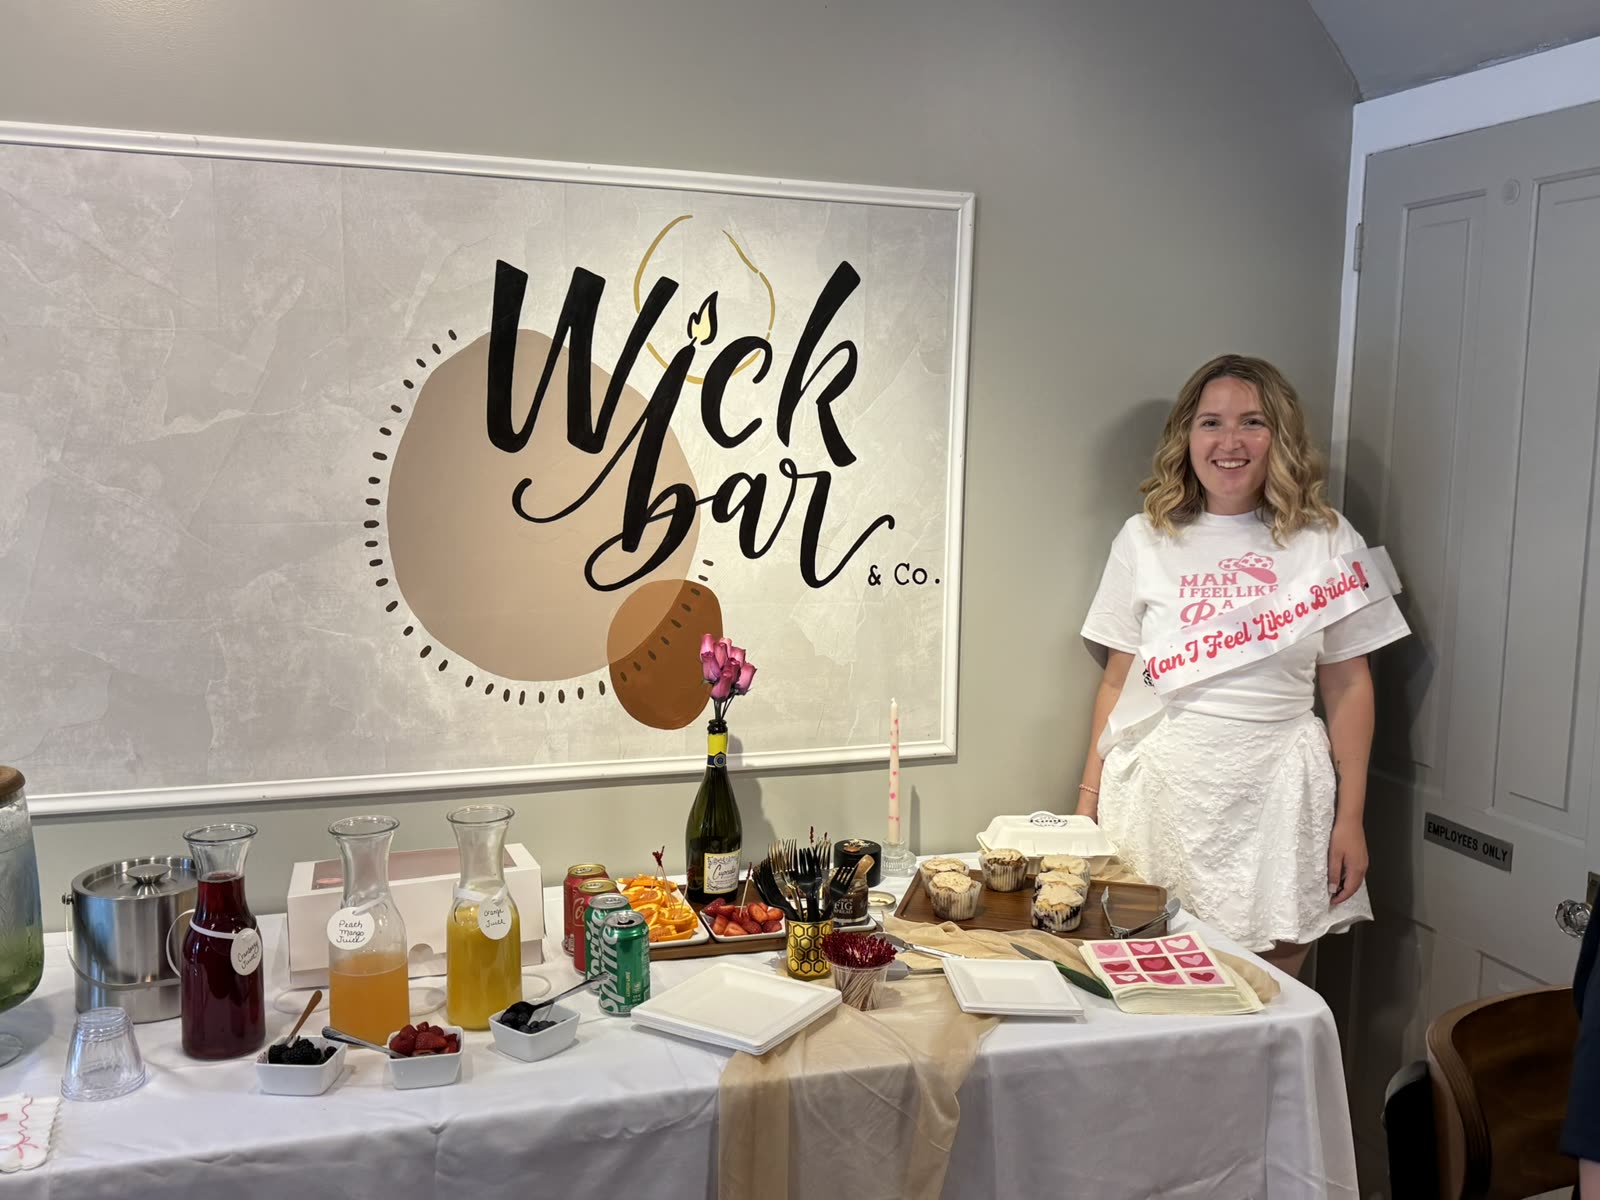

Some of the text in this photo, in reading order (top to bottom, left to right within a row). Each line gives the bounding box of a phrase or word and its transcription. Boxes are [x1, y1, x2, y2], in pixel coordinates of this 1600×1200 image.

[487, 260, 860, 523] Wick
[585, 445, 894, 592] bar
[868, 563, 940, 586] & Co.
[1180, 572, 1238, 587] MAN
[1179, 588, 1185, 598] I
[1190, 587, 1233, 598] FEEL
[1222, 600, 1234, 609] A
[1185, 640, 1199, 663] I
[1203, 622, 1252, 659] Feel
[1253, 610, 1294, 641] Like
[1295, 602, 1309, 618] a
[1427, 821, 1508, 862] EMPLOYEES ONLY
[834, 901, 853, 910] FIG
[339, 919, 363, 928] Peach
[600, 926, 625, 1013] Sprite
